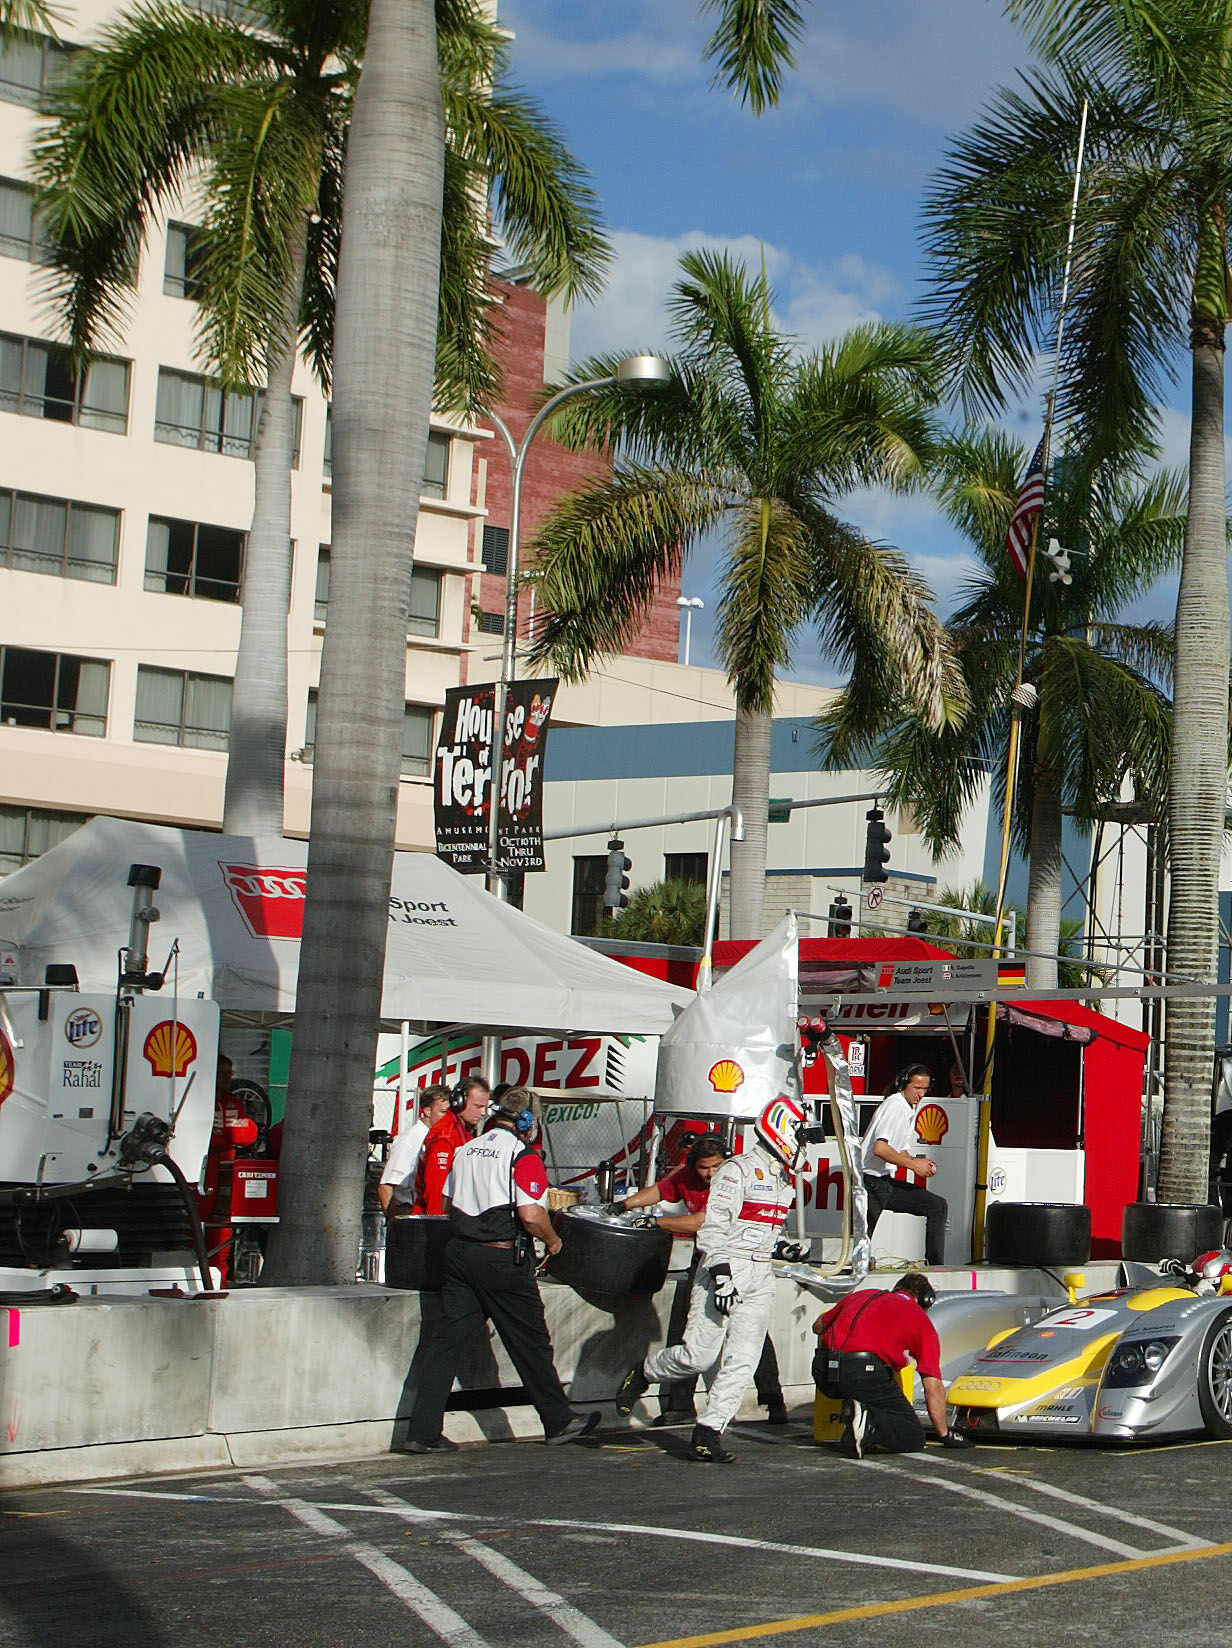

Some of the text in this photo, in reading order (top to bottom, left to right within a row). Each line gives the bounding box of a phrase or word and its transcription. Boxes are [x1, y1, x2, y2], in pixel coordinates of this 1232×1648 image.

[455, 698, 525, 746] House
[479, 746, 490, 766] of
[437, 744, 540, 820] Terror
[514, 825, 541, 834] PARK
[438, 842, 487, 851] BICENTENNIAL
[507, 846, 534, 857] THRU
[452, 853, 472, 863] PARK
[390, 896, 450, 912] Sport
[401, 914, 459, 927] Joest
[896, 966, 933, 975] Audi Sport
[894, 976, 932, 984] Team Joest
[68, 1019, 98, 1043] Lite
[63, 1068, 101, 1087] Rahal
[1054, 1310, 1095, 1325] 2
[985, 1347, 1048, 1360] Infineon
